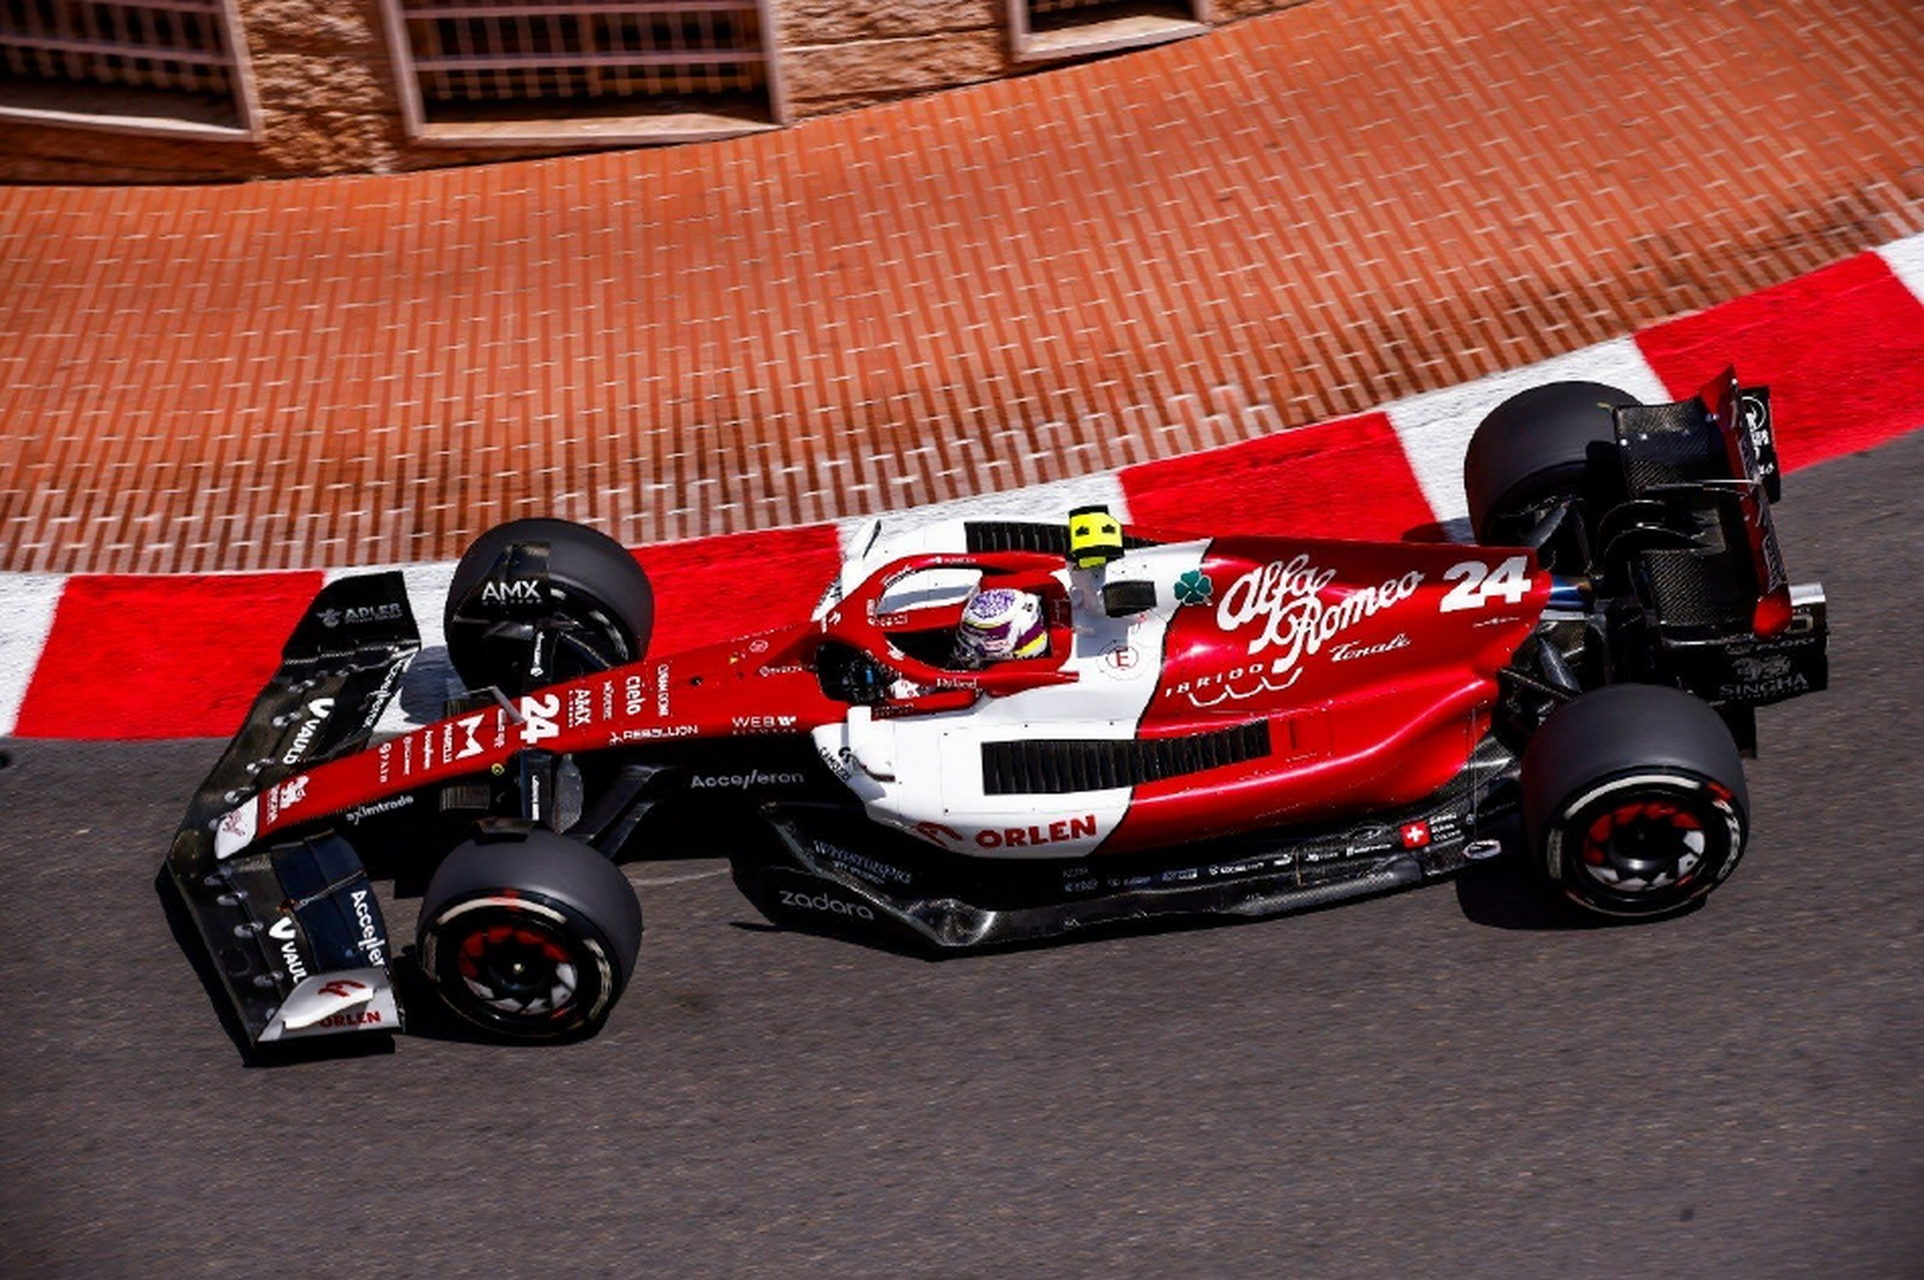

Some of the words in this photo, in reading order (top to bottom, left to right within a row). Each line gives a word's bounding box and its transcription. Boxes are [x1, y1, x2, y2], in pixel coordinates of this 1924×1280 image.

[482, 580, 541, 600] AMX
[1440, 555, 1532, 613] 24
[344, 603, 401, 620] ADLER
[1217, 554, 1336, 654] Alfa
[1272, 571, 1425, 674] Romeo
[1113, 646, 1129, 668] E
[1330, 633, 1411, 662] Tonale
[626, 675, 646, 716] cielo
[1165, 663, 1263, 697] IBRIDO
[1720, 673, 1808, 696] SINGHA
[520, 694, 560, 744] 24
[574, 689, 592, 726] AMX
[732, 716, 774, 727] WEB
[283, 718, 320, 765] VAULD
[690, 769, 804, 790] Accelleron
[976, 814, 1097, 848] ORLEN
[779, 890, 874, 920] zadara
[281, 941, 308, 984] VAUL
[319, 1011, 382, 1028] ORLEN
